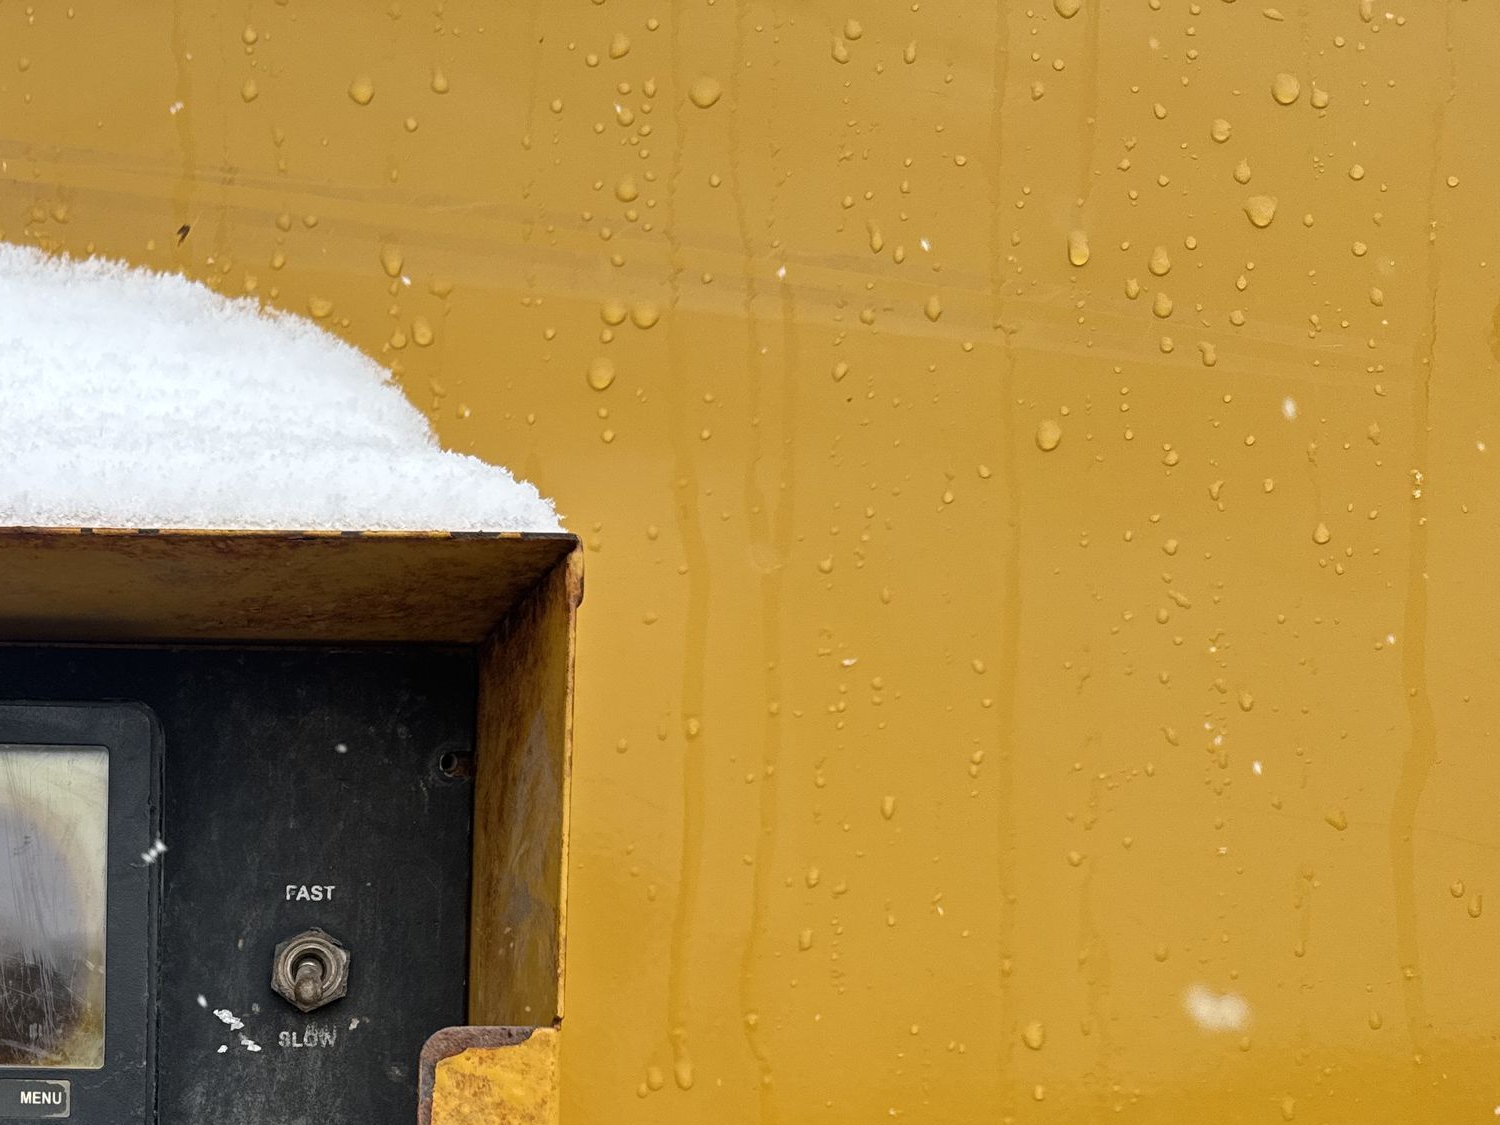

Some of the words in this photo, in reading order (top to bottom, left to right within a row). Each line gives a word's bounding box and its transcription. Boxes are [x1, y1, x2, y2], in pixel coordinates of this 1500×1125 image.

[285, 884, 336, 901] FAST
[278, 1030, 337, 1048] SLOW
[20, 1091, 62, 1105] MENU
